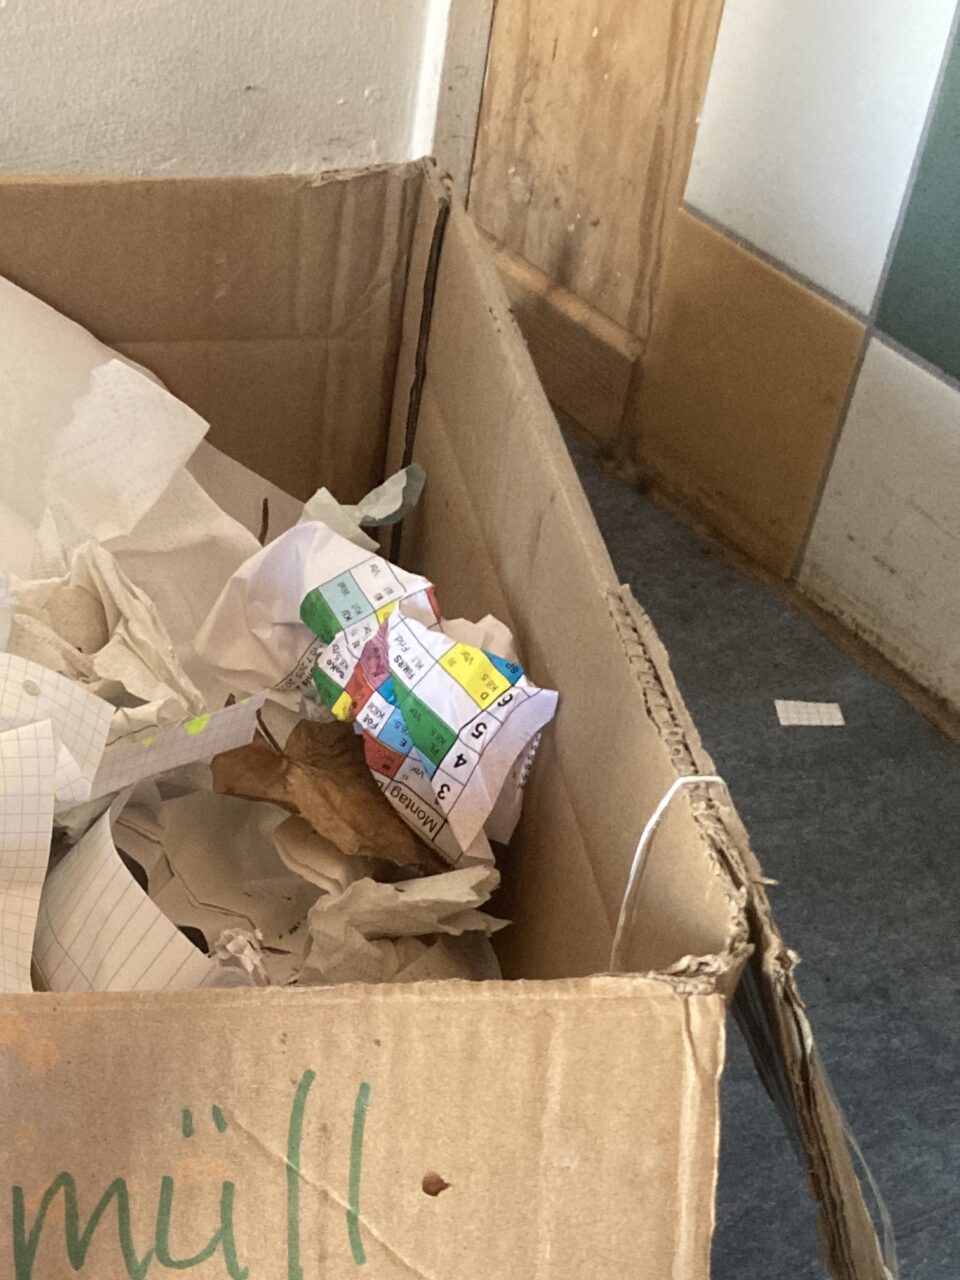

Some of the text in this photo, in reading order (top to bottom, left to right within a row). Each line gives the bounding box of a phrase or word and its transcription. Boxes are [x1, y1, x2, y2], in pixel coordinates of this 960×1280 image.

[497, 694, 514, 708] 6
[470, 722, 487, 739] 5
[453, 754, 466, 770] 4
[436, 783, 451, 800] 3
[391, 788, 437, 831] Montag
